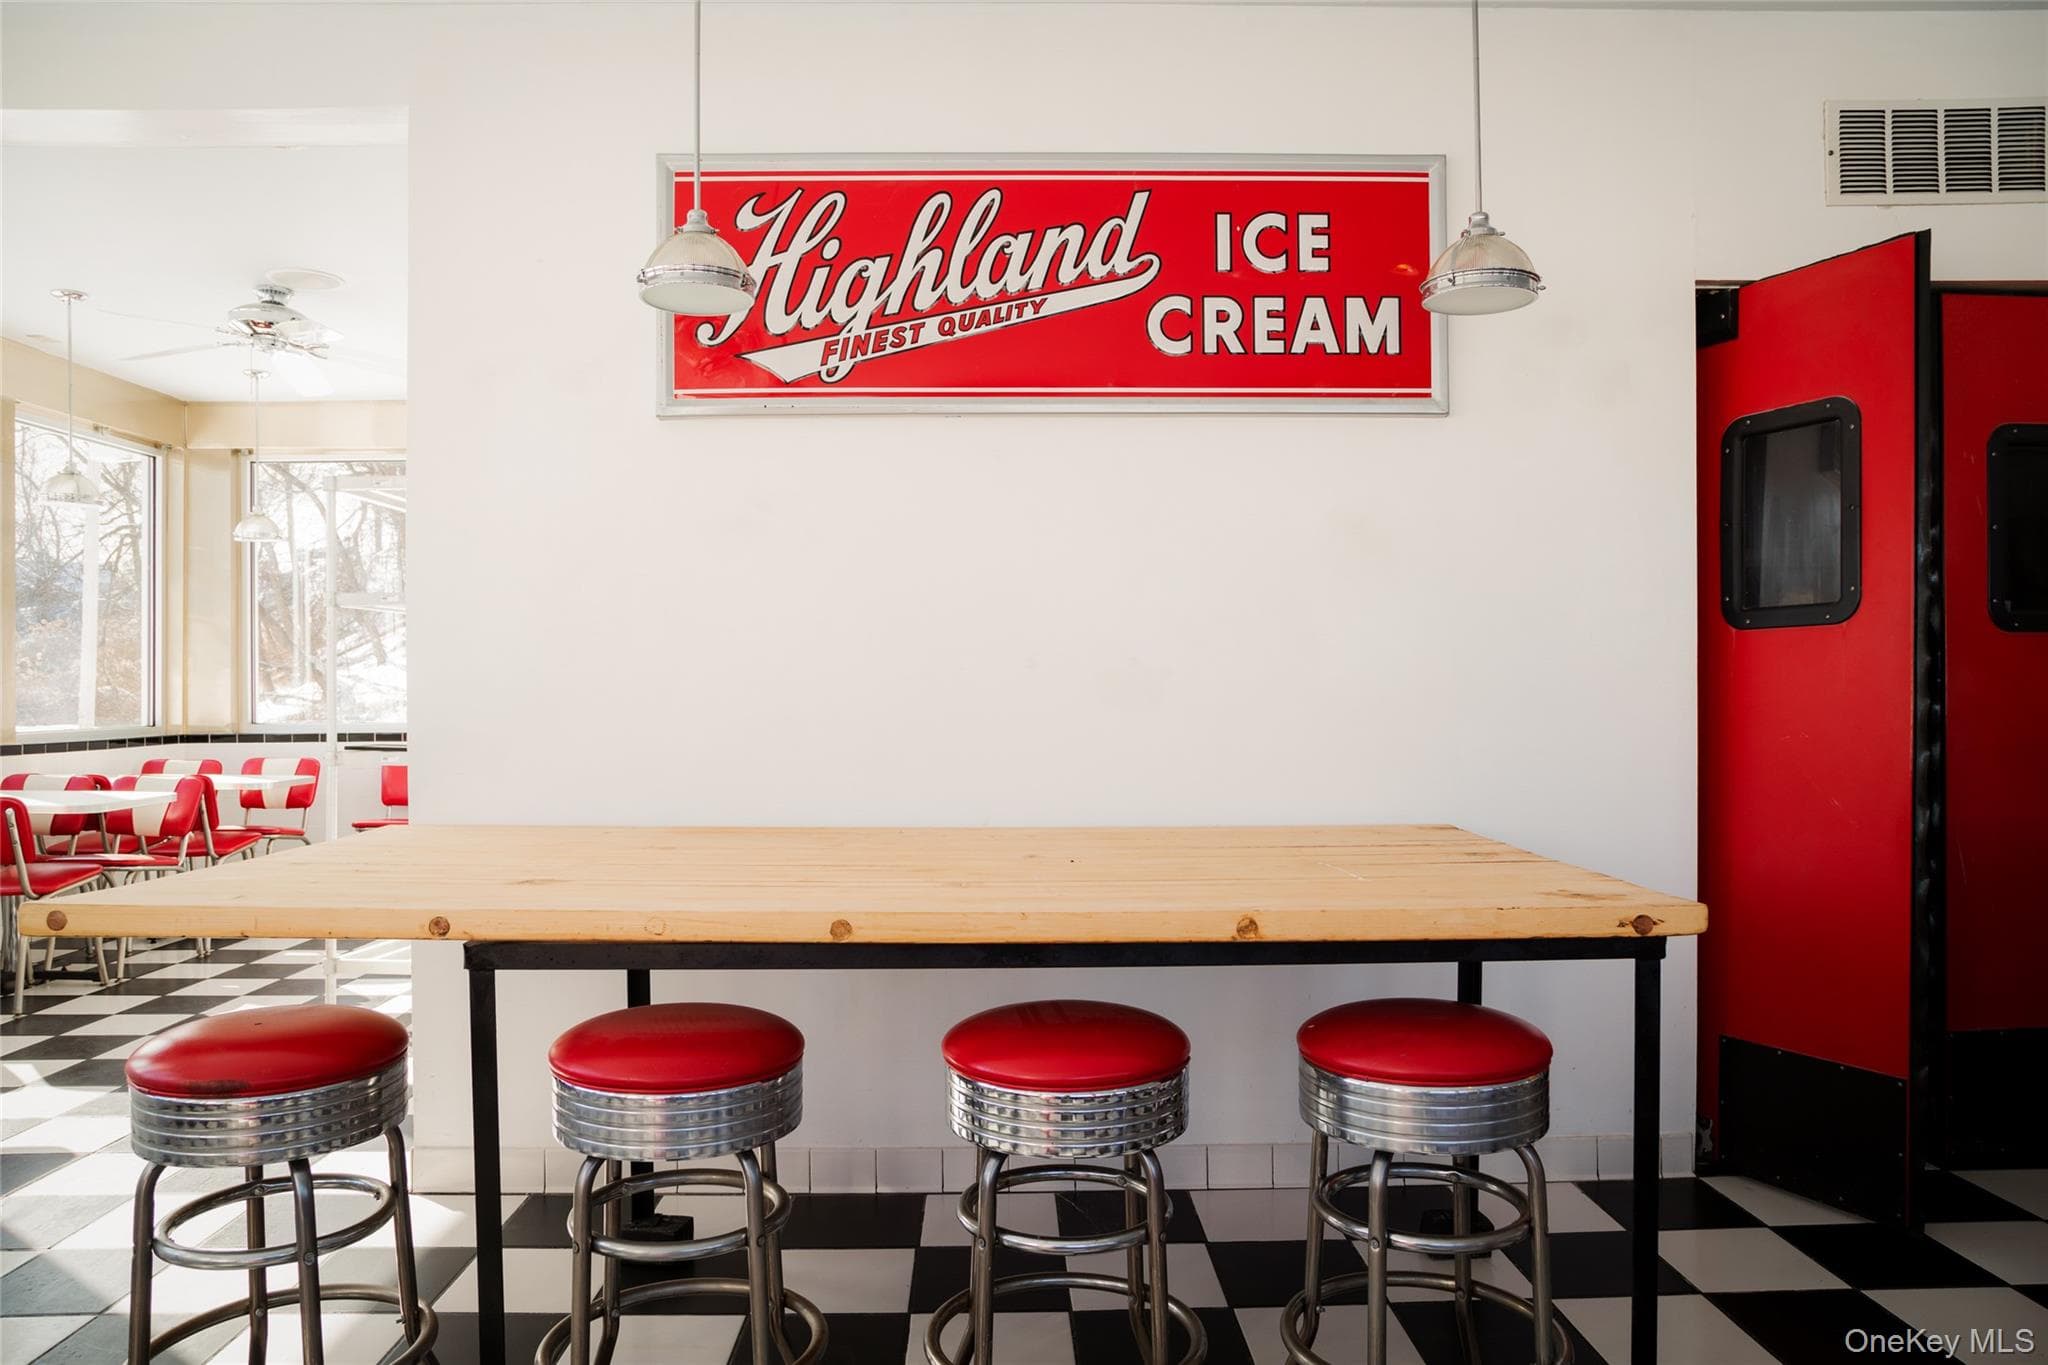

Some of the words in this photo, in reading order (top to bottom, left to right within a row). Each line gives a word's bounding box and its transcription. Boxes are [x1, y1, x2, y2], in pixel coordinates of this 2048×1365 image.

[1215, 212, 1330, 274] ICE
[696, 187, 1160, 384] Highland
[820, 322, 926, 366] FINEST
[937, 297, 1049, 337] QUALITY
[1146, 294, 1401, 357] CREAM
